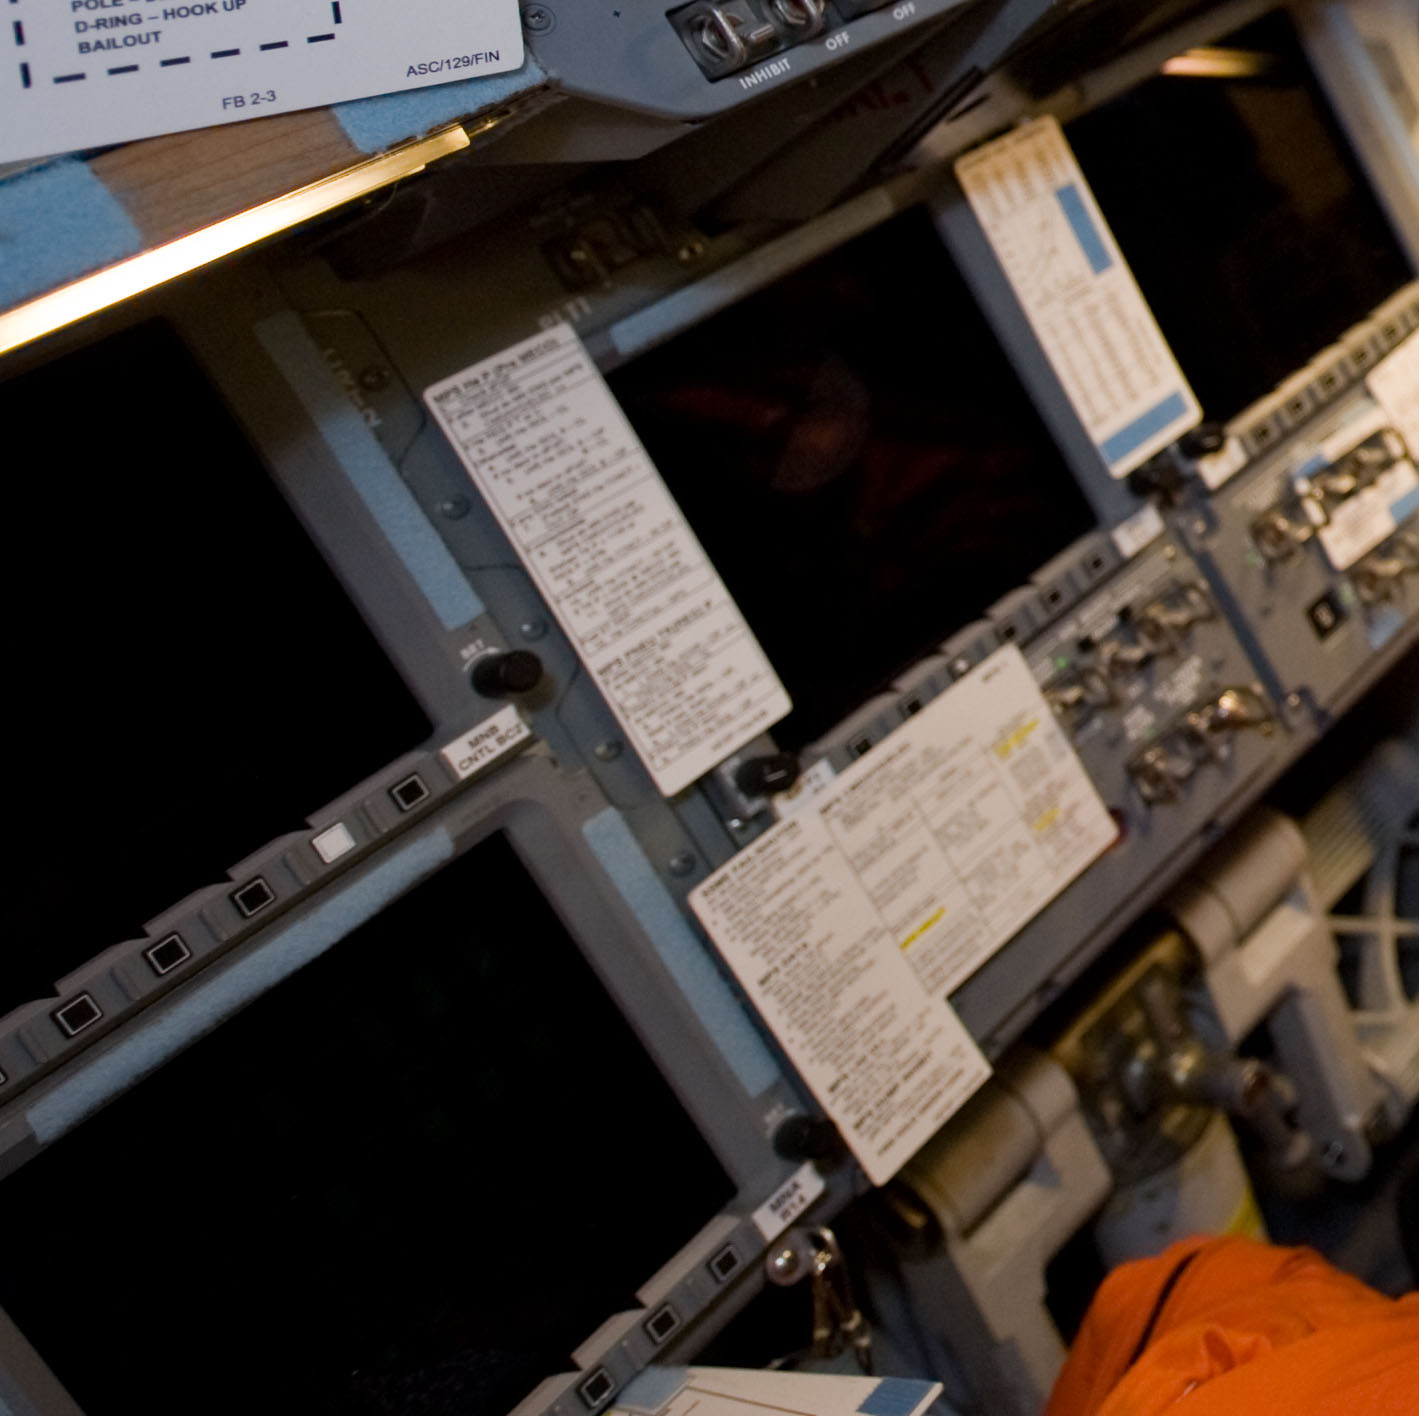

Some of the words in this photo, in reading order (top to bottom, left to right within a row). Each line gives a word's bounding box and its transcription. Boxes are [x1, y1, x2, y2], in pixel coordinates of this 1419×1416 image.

[74, 13, 143, 34] D-RING
[162, 1, 219, 21] HOOK
[893, 2, 917, 21] OFF
[78, 31, 162, 55] BAILOUT
[825, 32, 850, 52] OFF
[406, 50, 500, 77] ASC/129/FIN
[739, 58, 791, 89] INHIBIT
[222, 95, 245, 110] FB
[251, 90, 277, 106] 2-3
